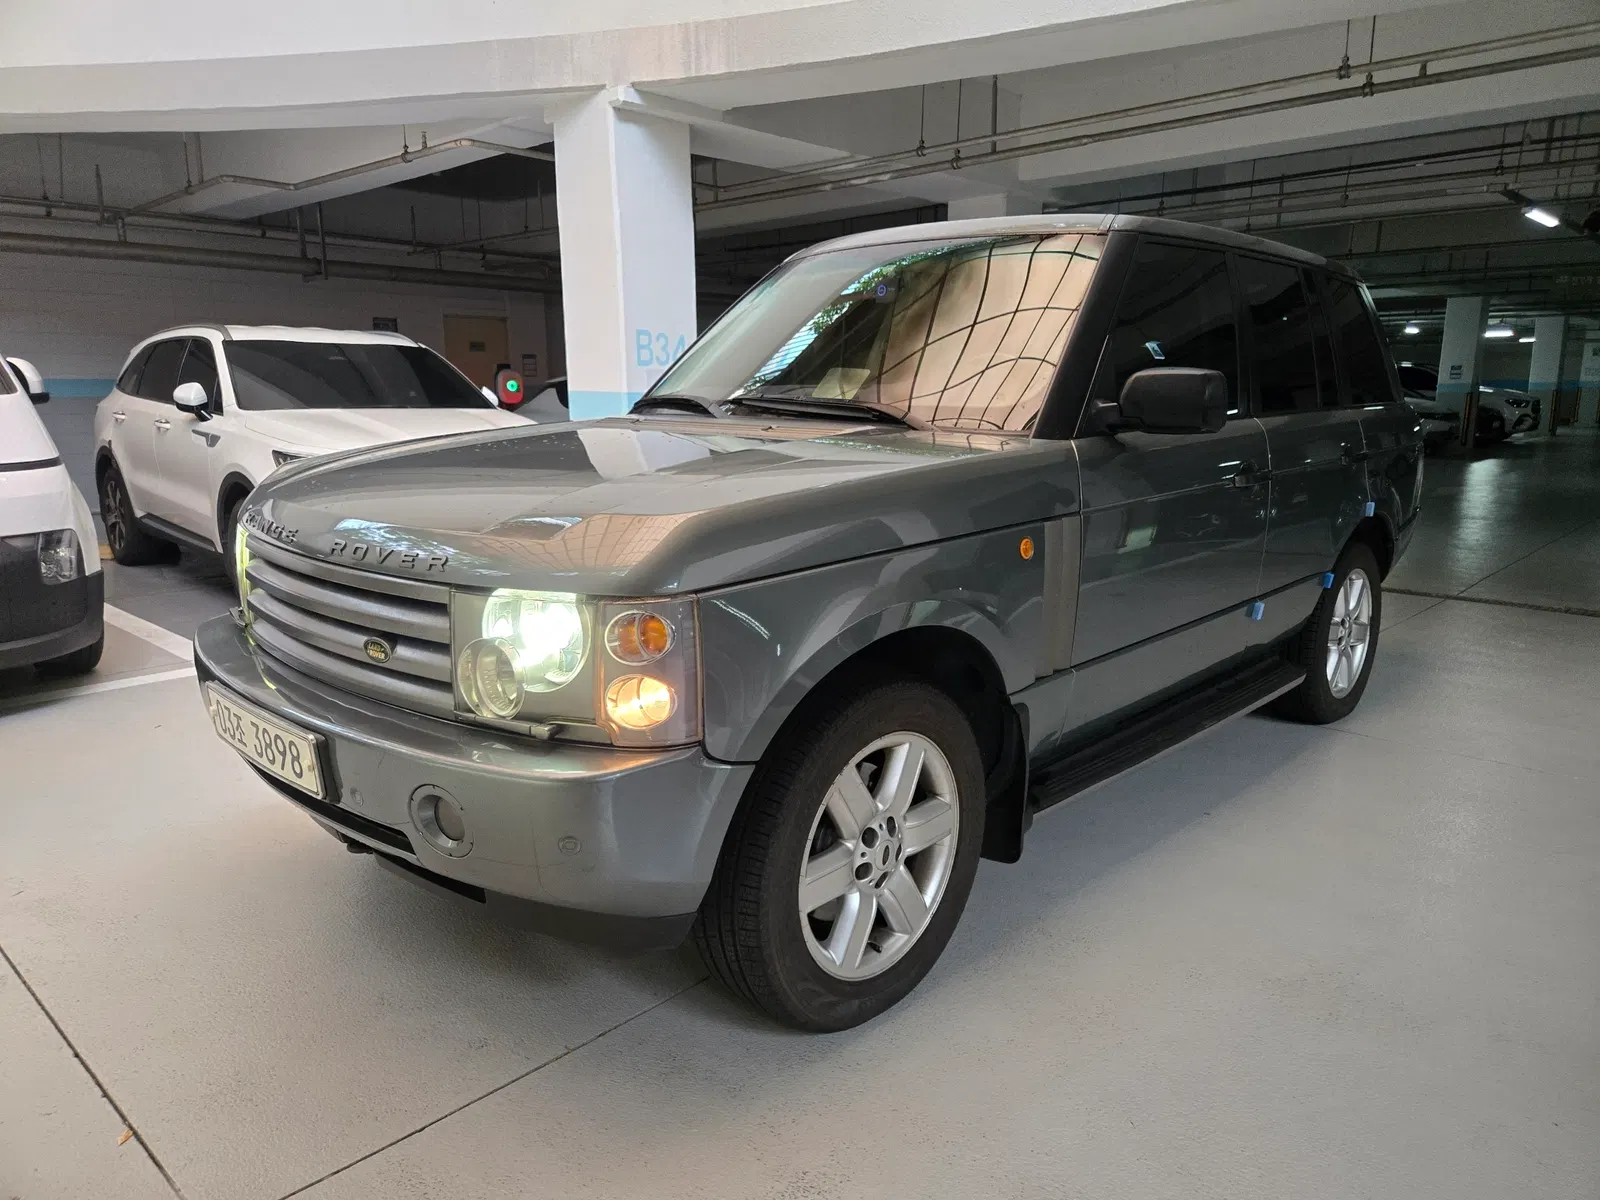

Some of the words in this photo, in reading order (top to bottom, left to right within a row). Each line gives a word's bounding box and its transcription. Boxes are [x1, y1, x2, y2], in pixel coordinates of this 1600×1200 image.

[244, 512, 299, 544] RANGE
[330, 538, 449, 572] ROVER
[250, 720, 304, 779] 3898
